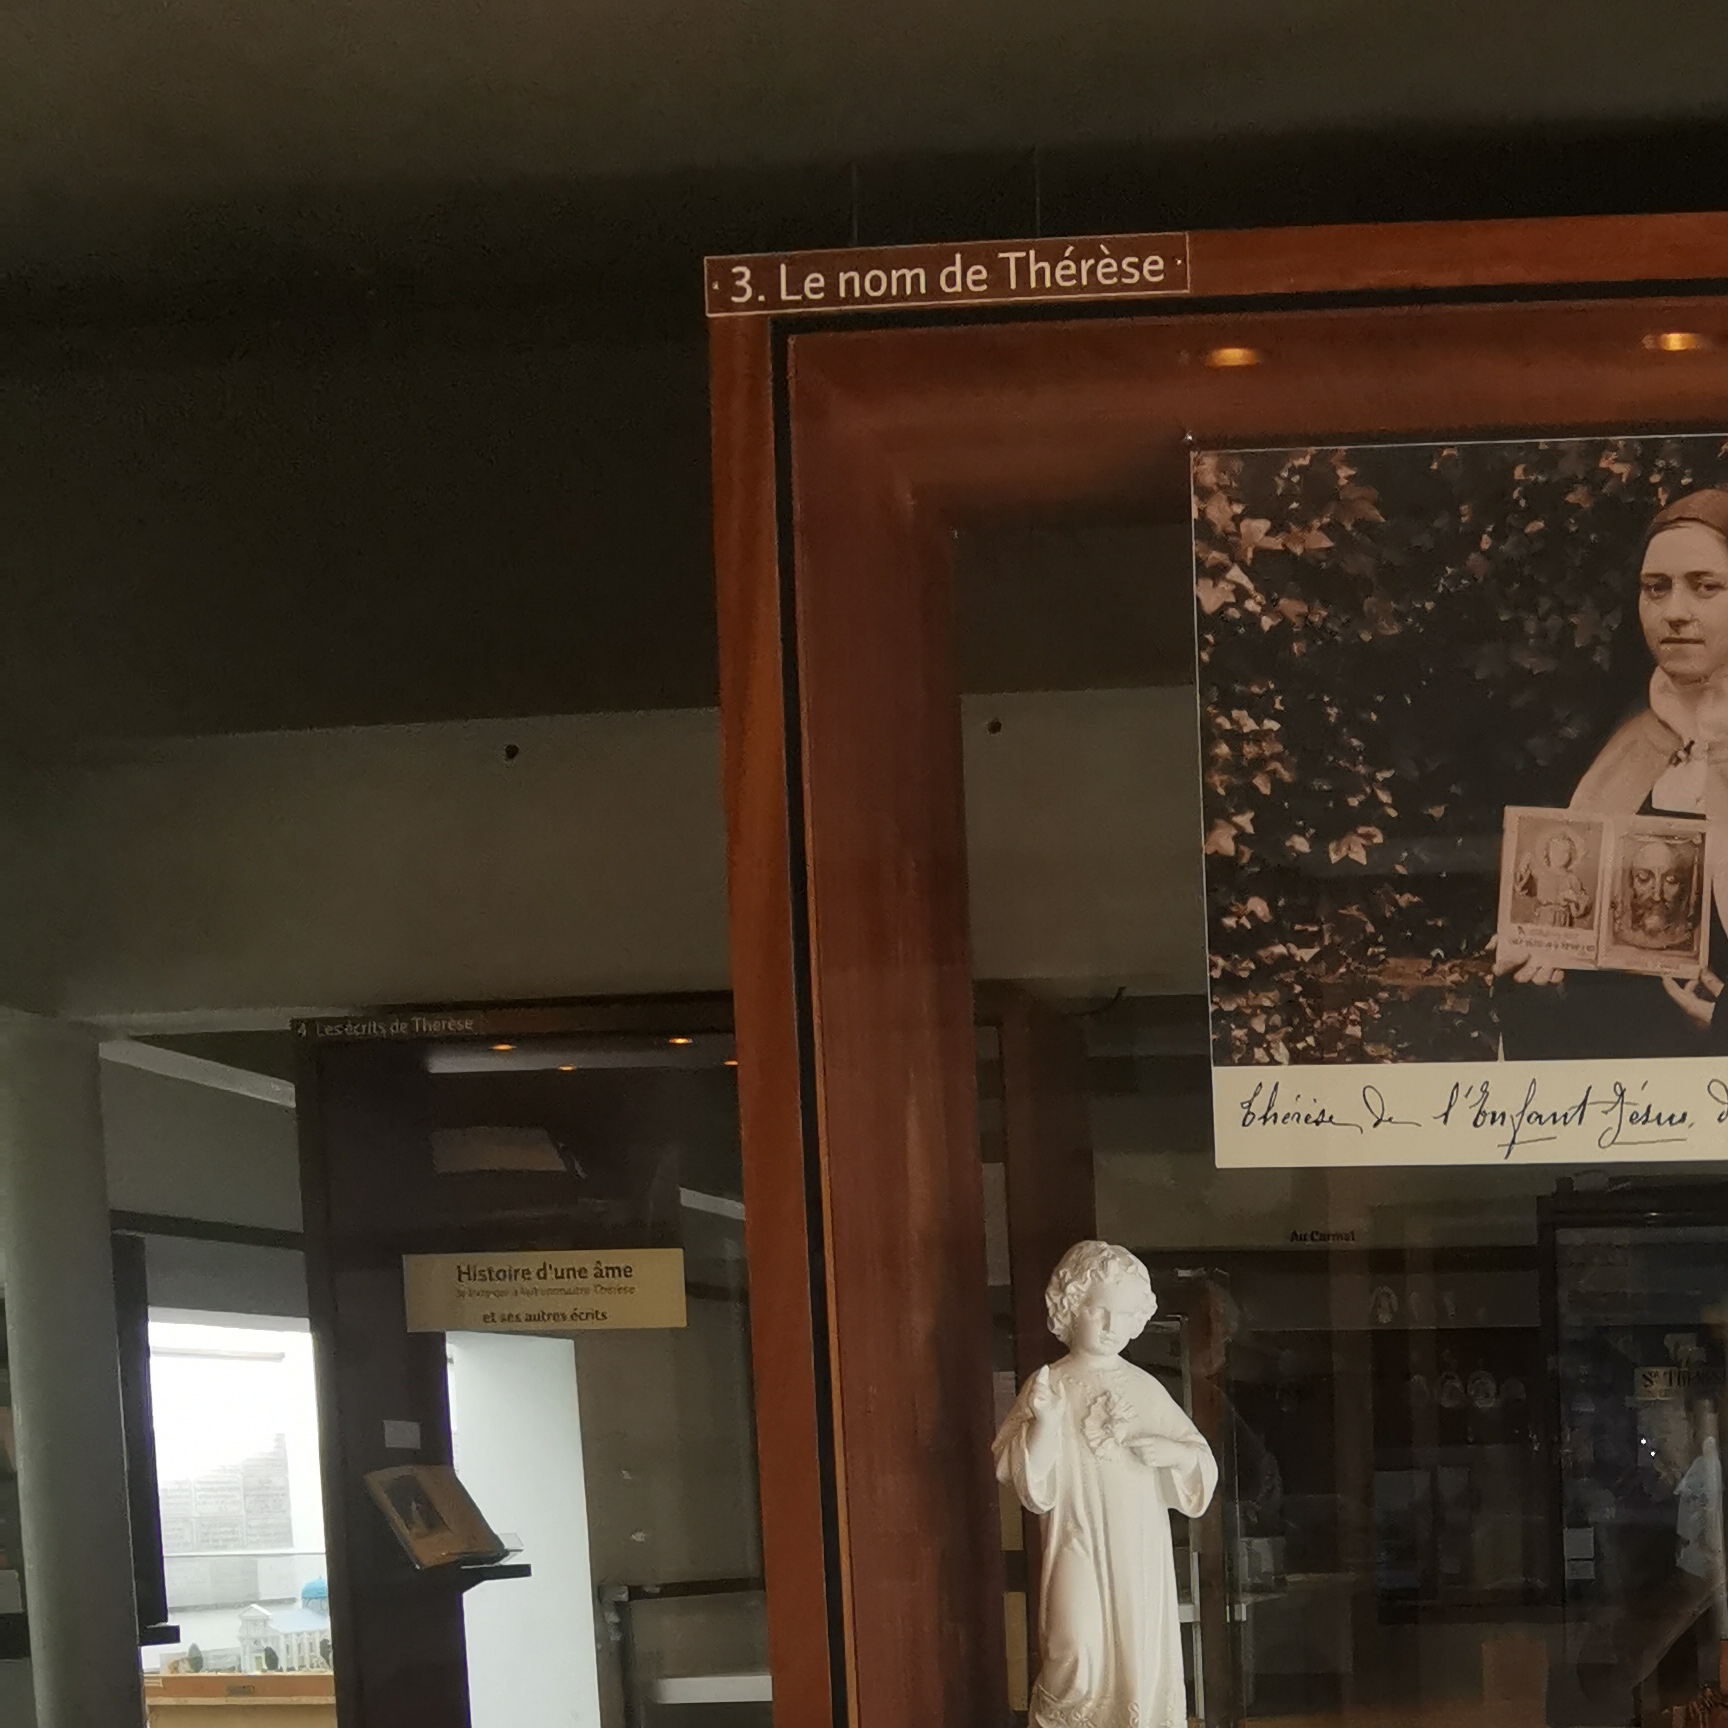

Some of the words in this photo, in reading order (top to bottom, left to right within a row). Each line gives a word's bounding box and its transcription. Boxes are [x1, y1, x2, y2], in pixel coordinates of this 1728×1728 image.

[731, 265, 766, 304] 3.
[780, 262, 825, 301] Le
[839, 266, 927, 299] nom
[939, 252, 989, 293] de
[998, 245, 1165, 290] Thérèse
[390, 1018, 408, 1035] de
[1241, 1080, 1363, 1135] Thérèse
[1362, 1085, 1422, 1128] de
[1433, 1077, 1594, 1160] l'Enfant
[456, 1264, 532, 1283] Histoire
[536, 1261, 588, 1282] d'une
[593, 1260, 634, 1279] âme
[483, 1312, 498, 1324] et
[525, 1310, 568, 1323] autres
[570, 1307, 608, 1321] écrits
